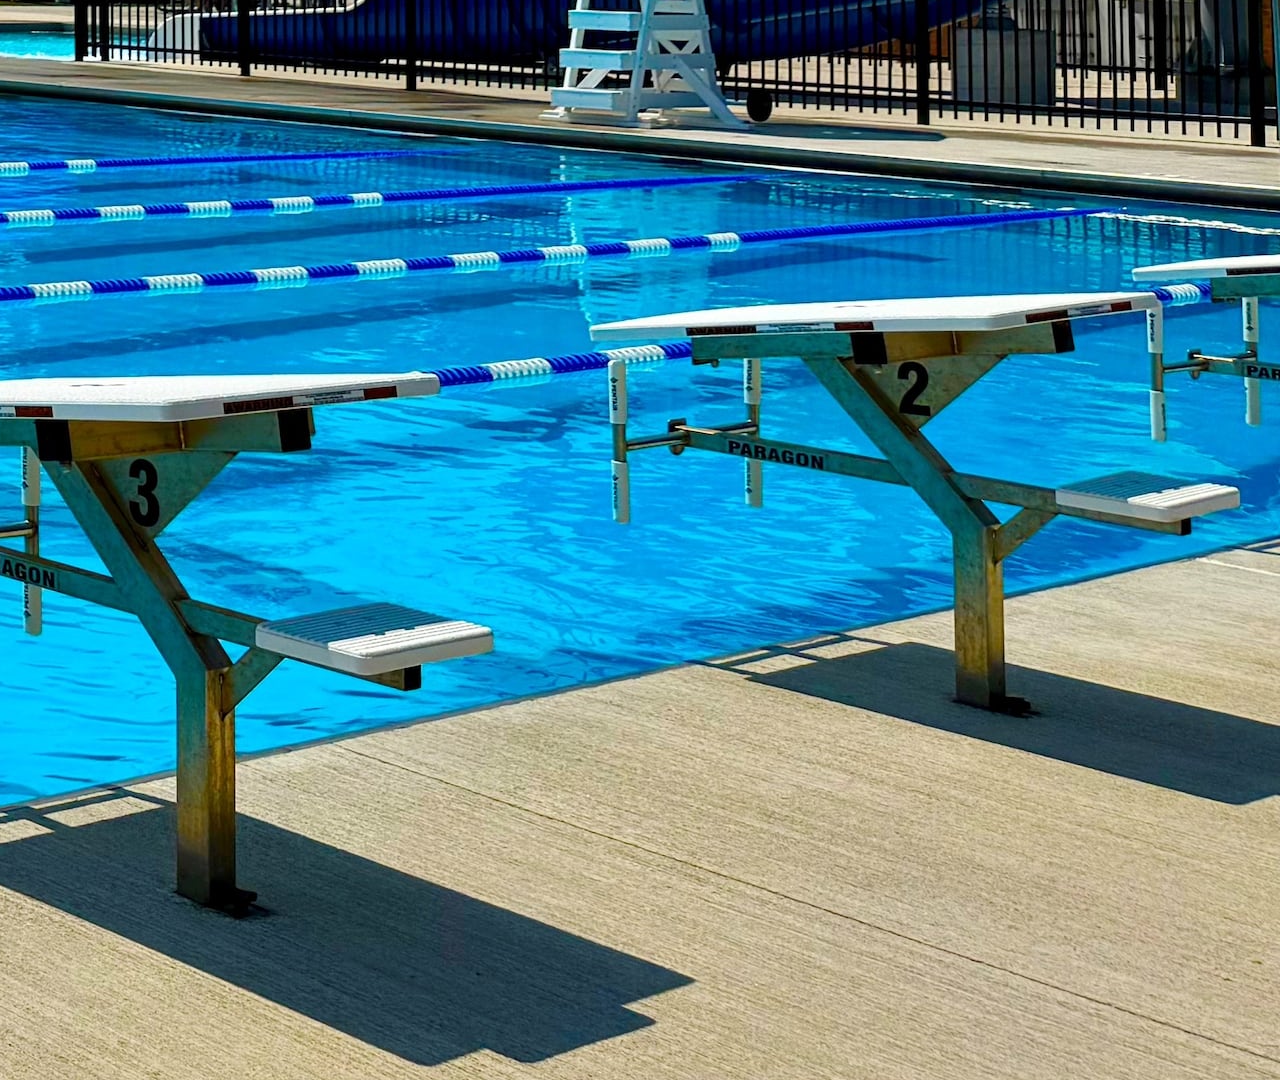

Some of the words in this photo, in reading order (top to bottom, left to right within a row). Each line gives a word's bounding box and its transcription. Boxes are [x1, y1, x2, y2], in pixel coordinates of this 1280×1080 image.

[897, 361, 931, 416] 2
[727, 440, 824, 470] PARAGON
[129, 458, 160, 527] 3
